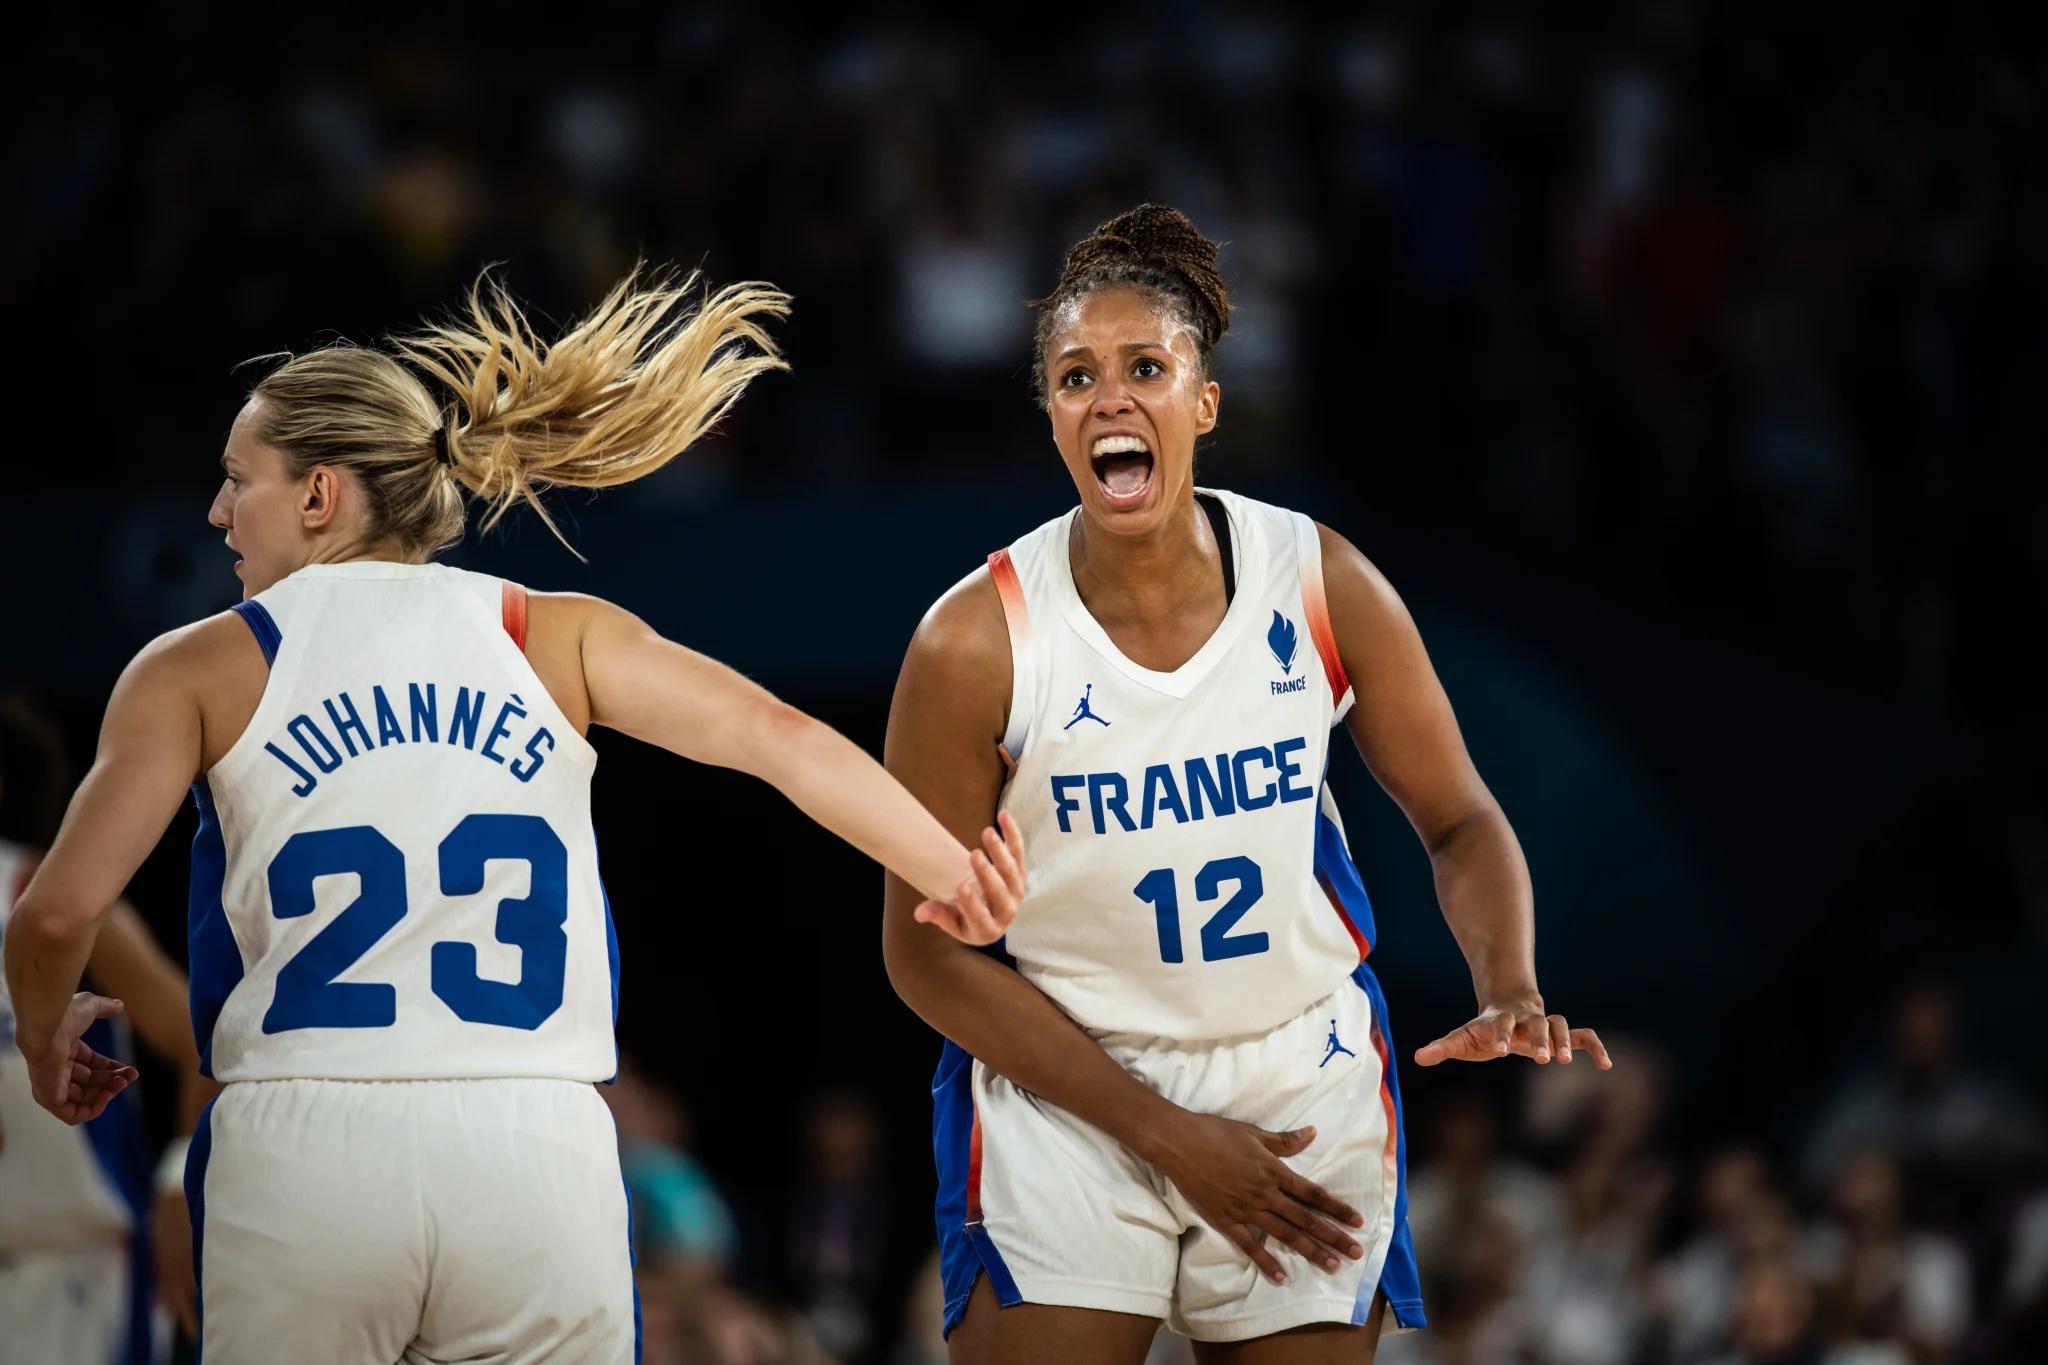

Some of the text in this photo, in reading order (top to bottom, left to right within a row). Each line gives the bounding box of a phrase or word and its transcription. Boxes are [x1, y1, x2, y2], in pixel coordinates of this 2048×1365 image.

[264, 682, 556, 798] JOHANNÈS
[1270, 675, 1306, 696] FRANCE
[1051, 736, 1314, 834] FRANCE
[262, 812, 569, 1034] 23
[1133, 855, 1270, 964] 12
